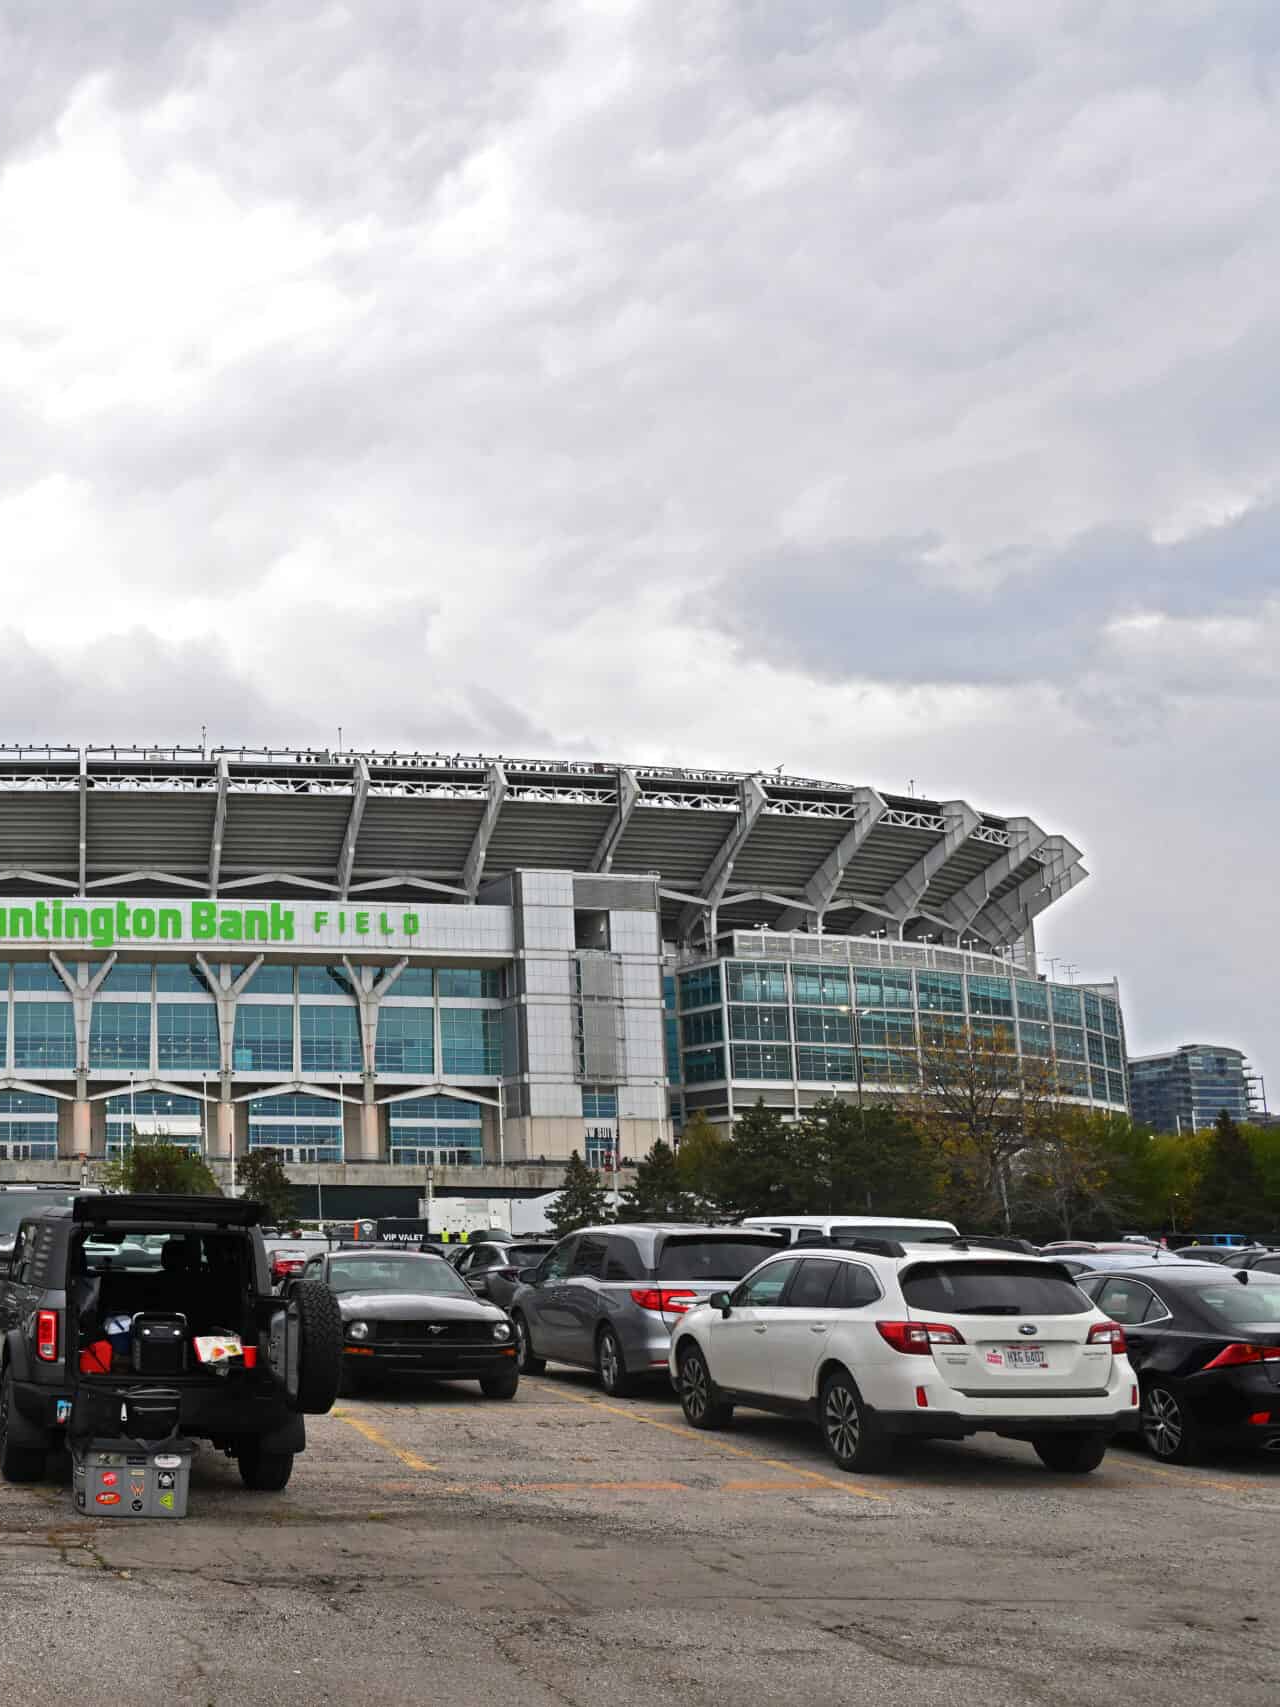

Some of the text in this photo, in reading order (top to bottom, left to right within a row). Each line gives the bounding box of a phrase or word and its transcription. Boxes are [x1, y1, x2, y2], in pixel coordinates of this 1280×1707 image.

[191, 900, 296, 941] Bank
[313, 911, 419, 935] FIELD
[382, 1233, 424, 1241] VIP VALET
